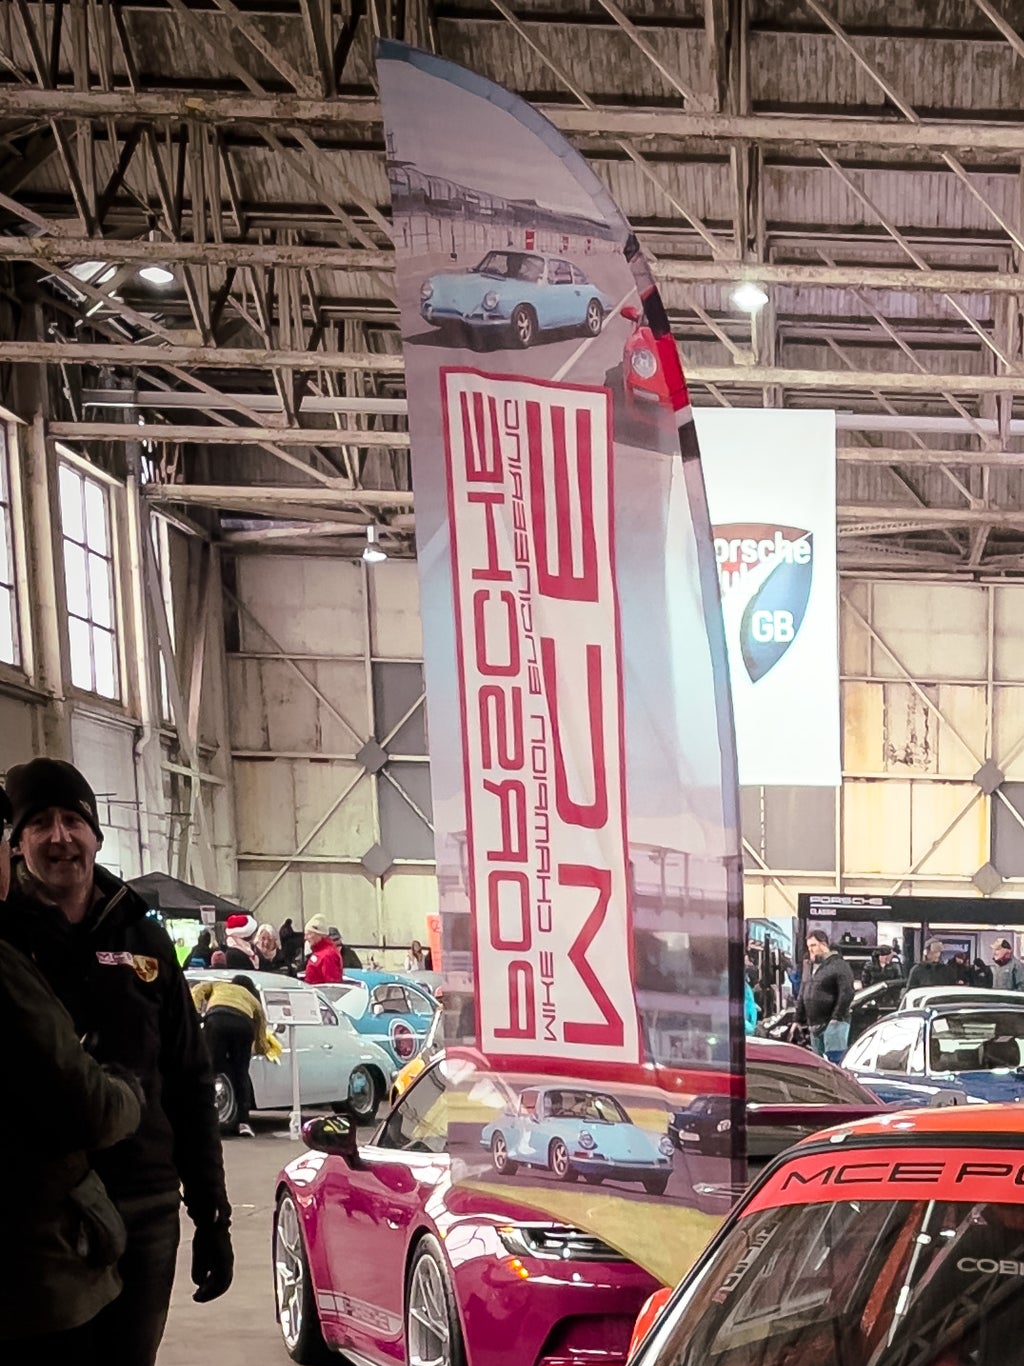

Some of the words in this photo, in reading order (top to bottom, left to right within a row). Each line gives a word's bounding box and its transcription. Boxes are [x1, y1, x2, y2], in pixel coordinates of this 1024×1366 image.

[713, 531, 811, 565] orsche
[751, 609, 795, 643] GB
[809, 896, 883, 906] PORSCHE
